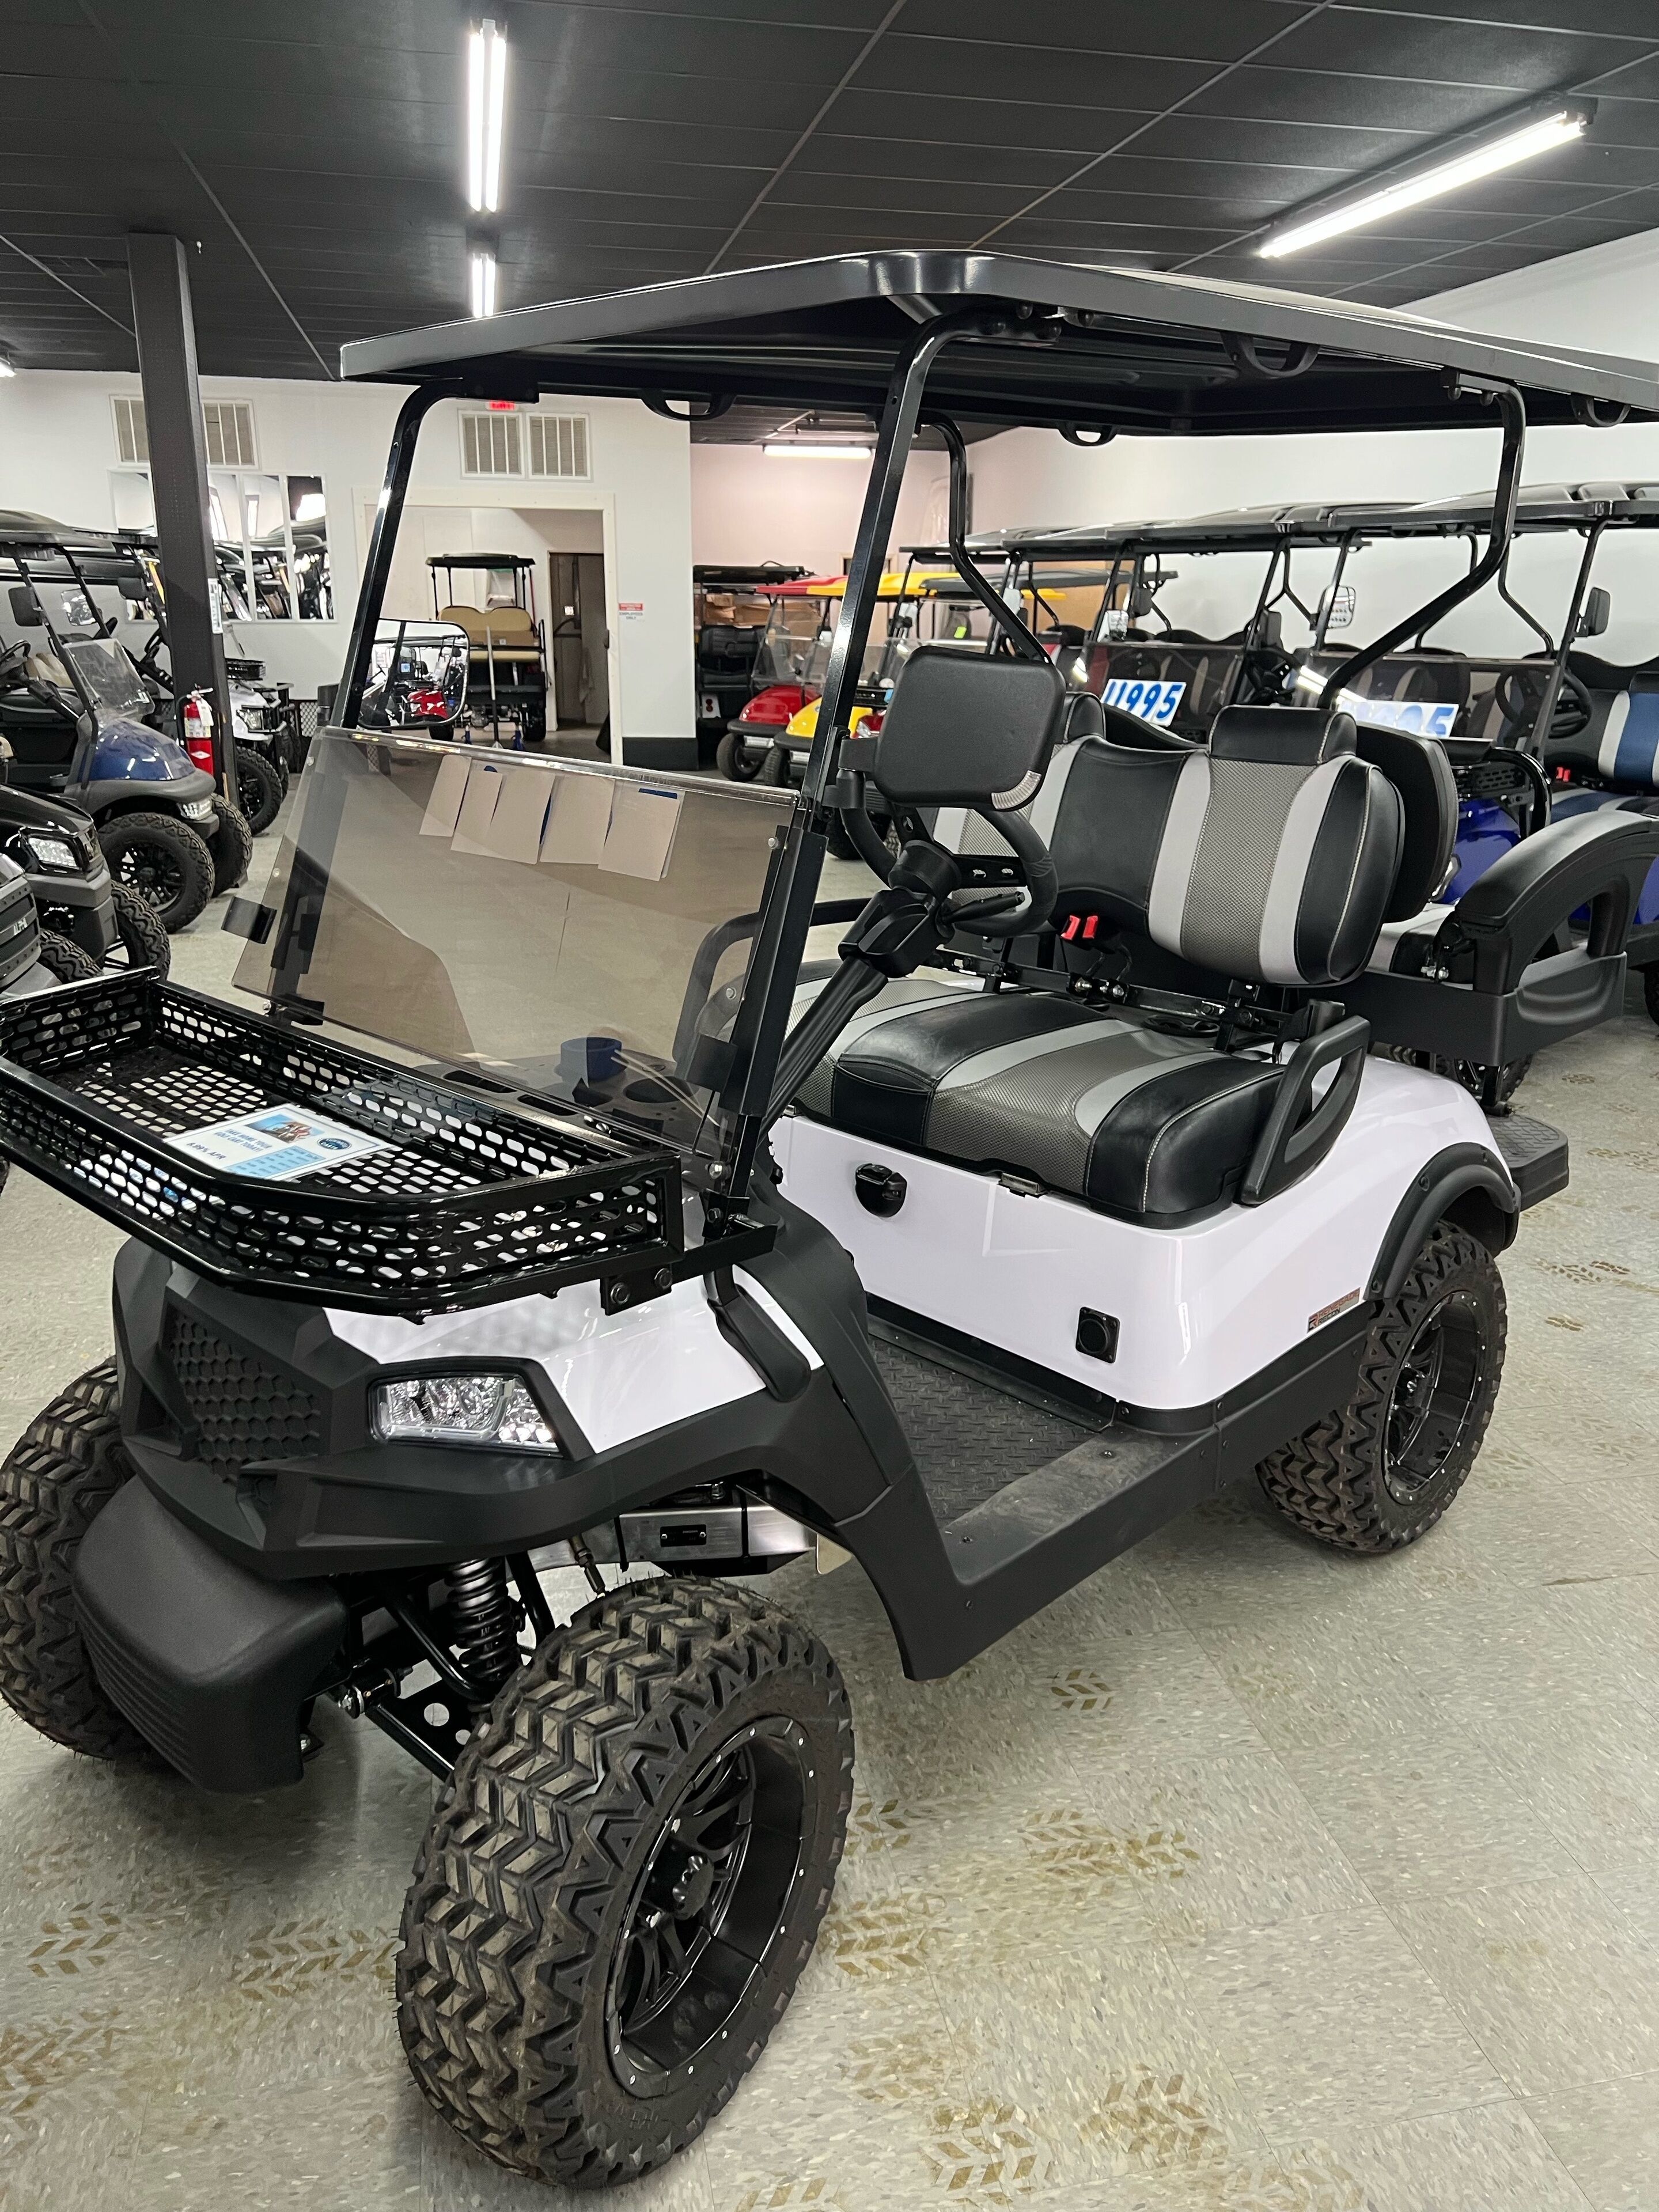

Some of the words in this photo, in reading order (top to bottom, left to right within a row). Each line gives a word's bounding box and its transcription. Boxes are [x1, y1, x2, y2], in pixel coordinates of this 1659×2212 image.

[1103, 681, 1183, 719] 11995
[207, 1151, 227, 1160] APR
[1319, 1289, 1359, 1317] RENEGADE
[1318, 1307, 1340, 1325] RECON
